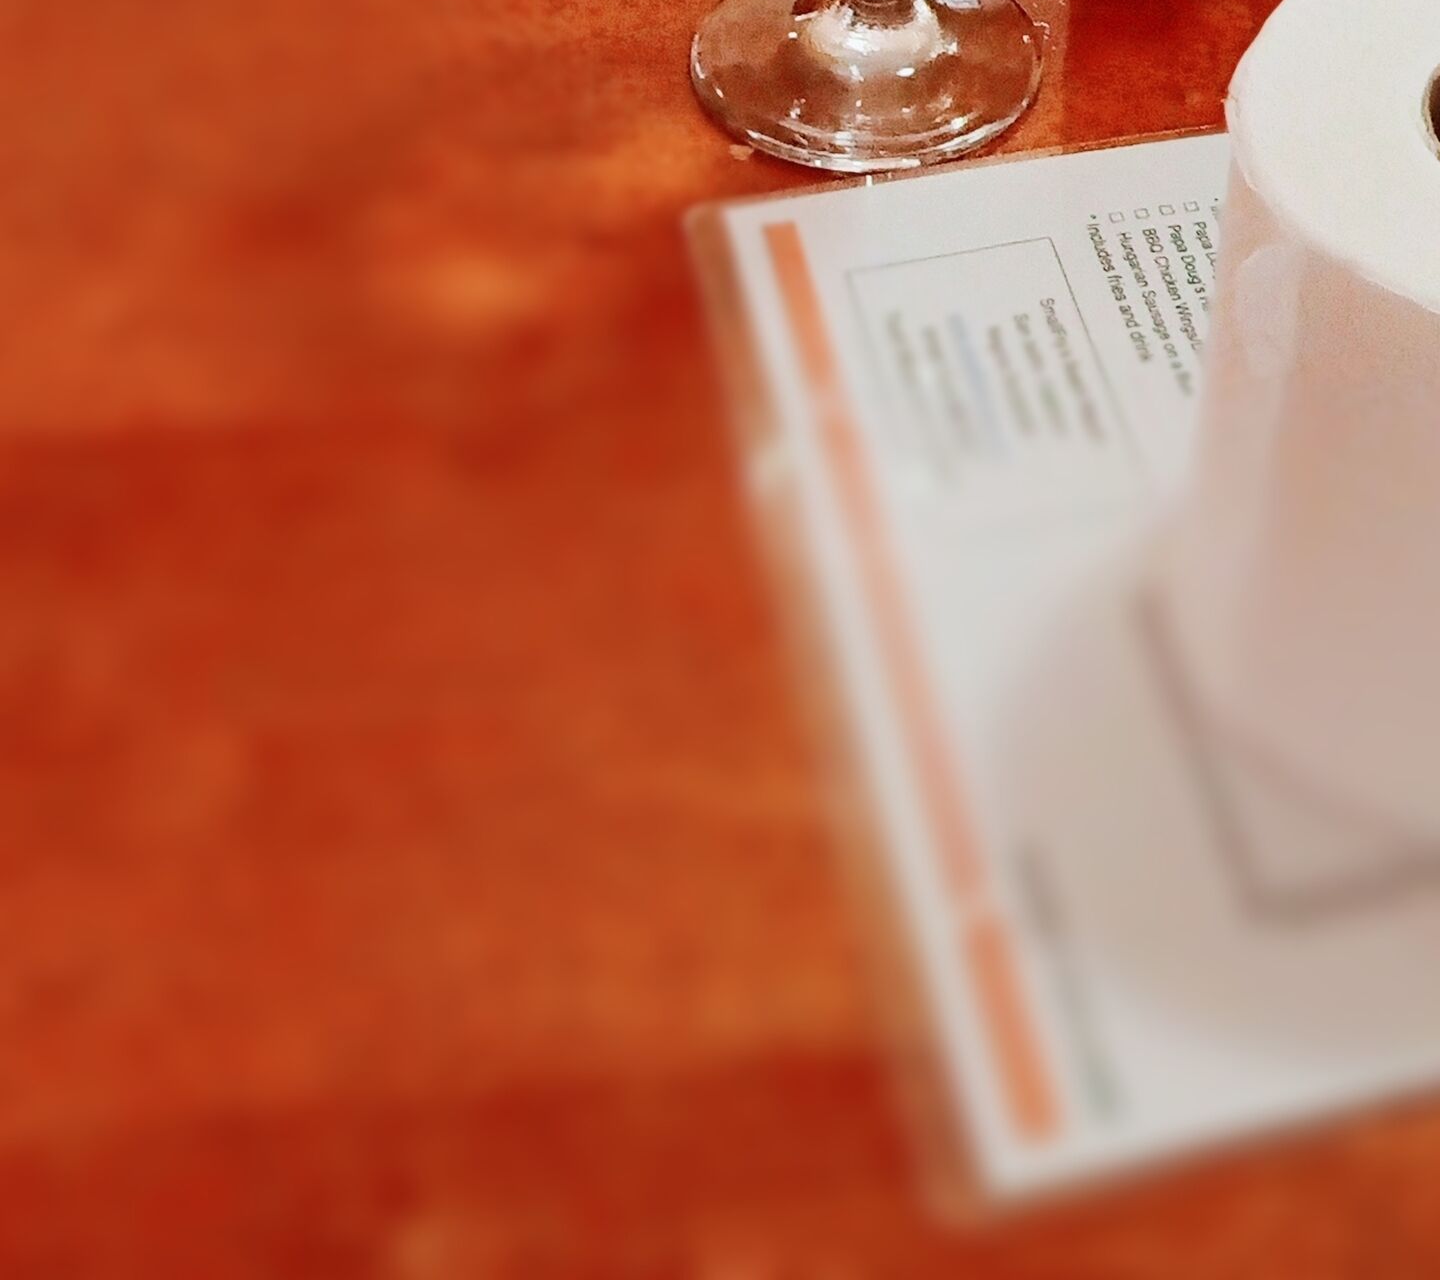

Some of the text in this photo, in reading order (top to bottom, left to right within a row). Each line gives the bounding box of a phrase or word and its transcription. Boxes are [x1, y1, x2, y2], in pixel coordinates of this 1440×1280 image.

[1142, 228, 1164, 254] BBQ
[1154, 255, 1181, 302] Chicken
[1168, 224, 1206, 294] Papa Doug's
[1194, 221, 1213, 250] Papa
[1087, 223, 1115, 273] Includes
[1107, 275, 1128, 302] fries
[1119, 304, 1140, 329] and
[1118, 231, 1149, 288] Hungarian
[1142, 290, 1171, 341] Sausage
[1164, 343, 1179, 359] on
